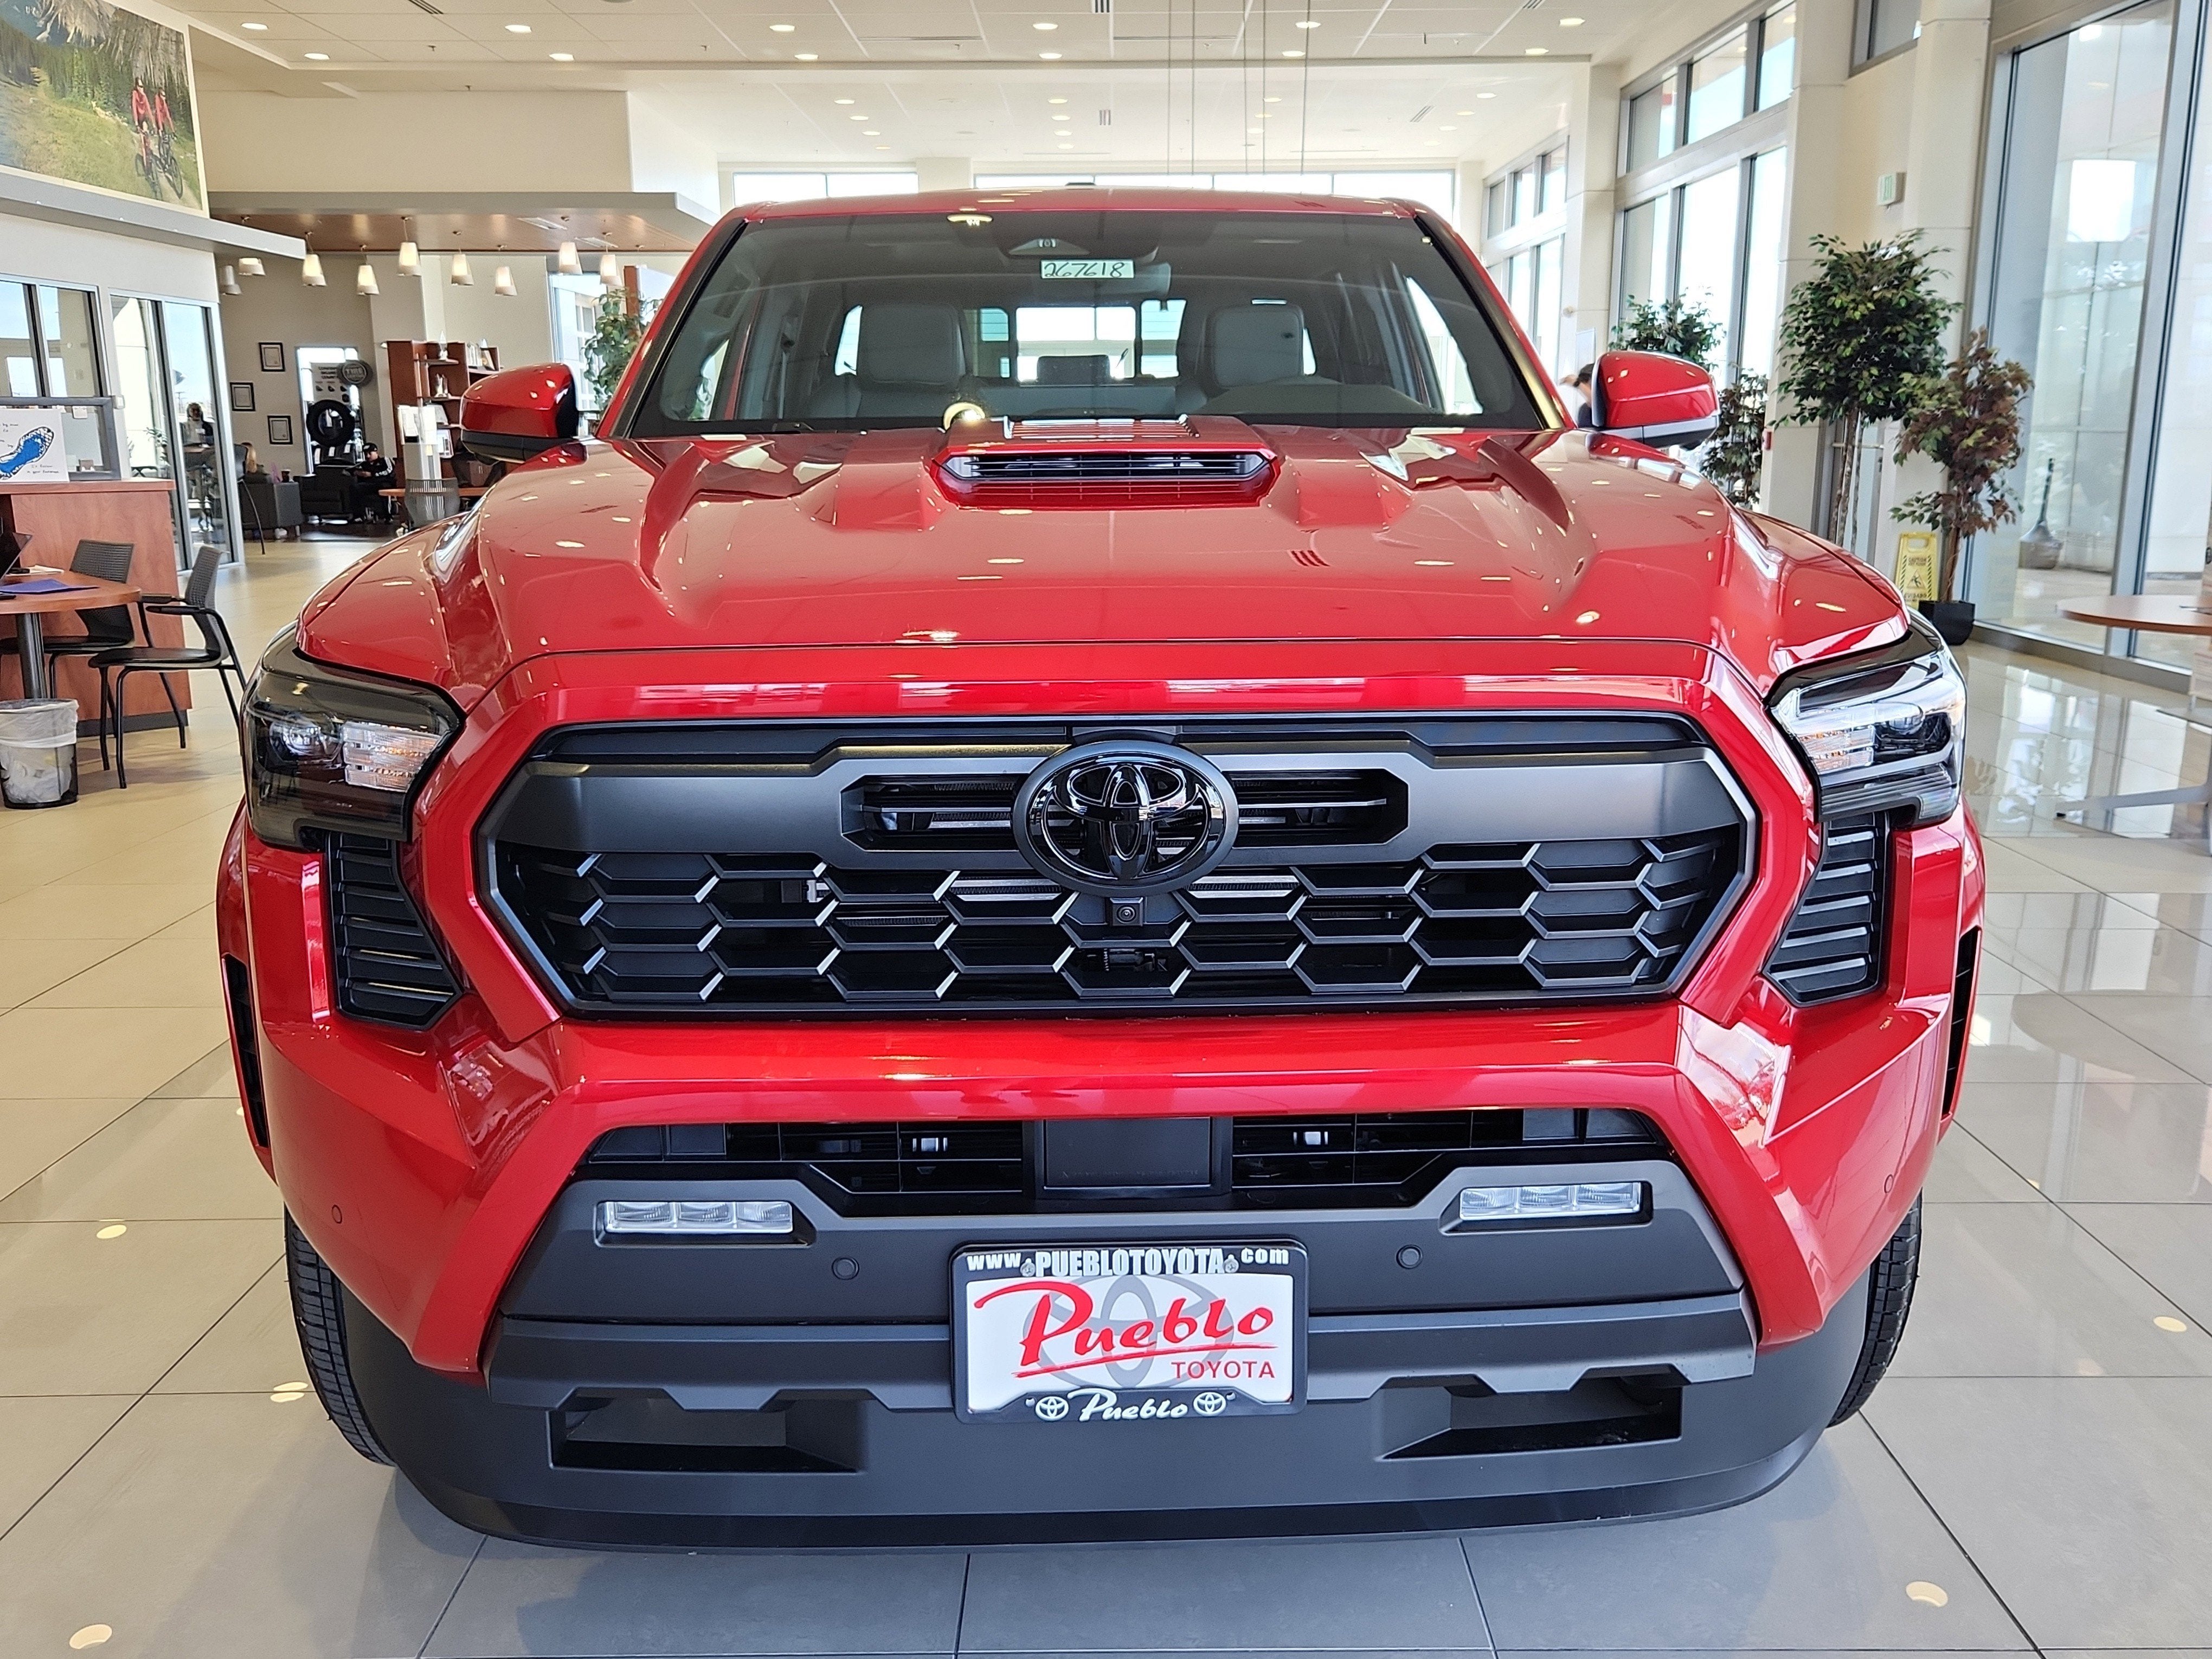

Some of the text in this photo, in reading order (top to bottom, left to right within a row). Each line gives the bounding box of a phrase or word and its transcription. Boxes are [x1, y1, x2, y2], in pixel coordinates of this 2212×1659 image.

[1044, 262, 1125, 278] 267618
[1036, 1248, 1225, 1277] PUEBLOTOYOTA
[974, 1281, 1274, 1366] Pueblo
[1171, 1360, 1275, 1379] TOYOTA
[1067, 1388, 1188, 1422] Pueblo
